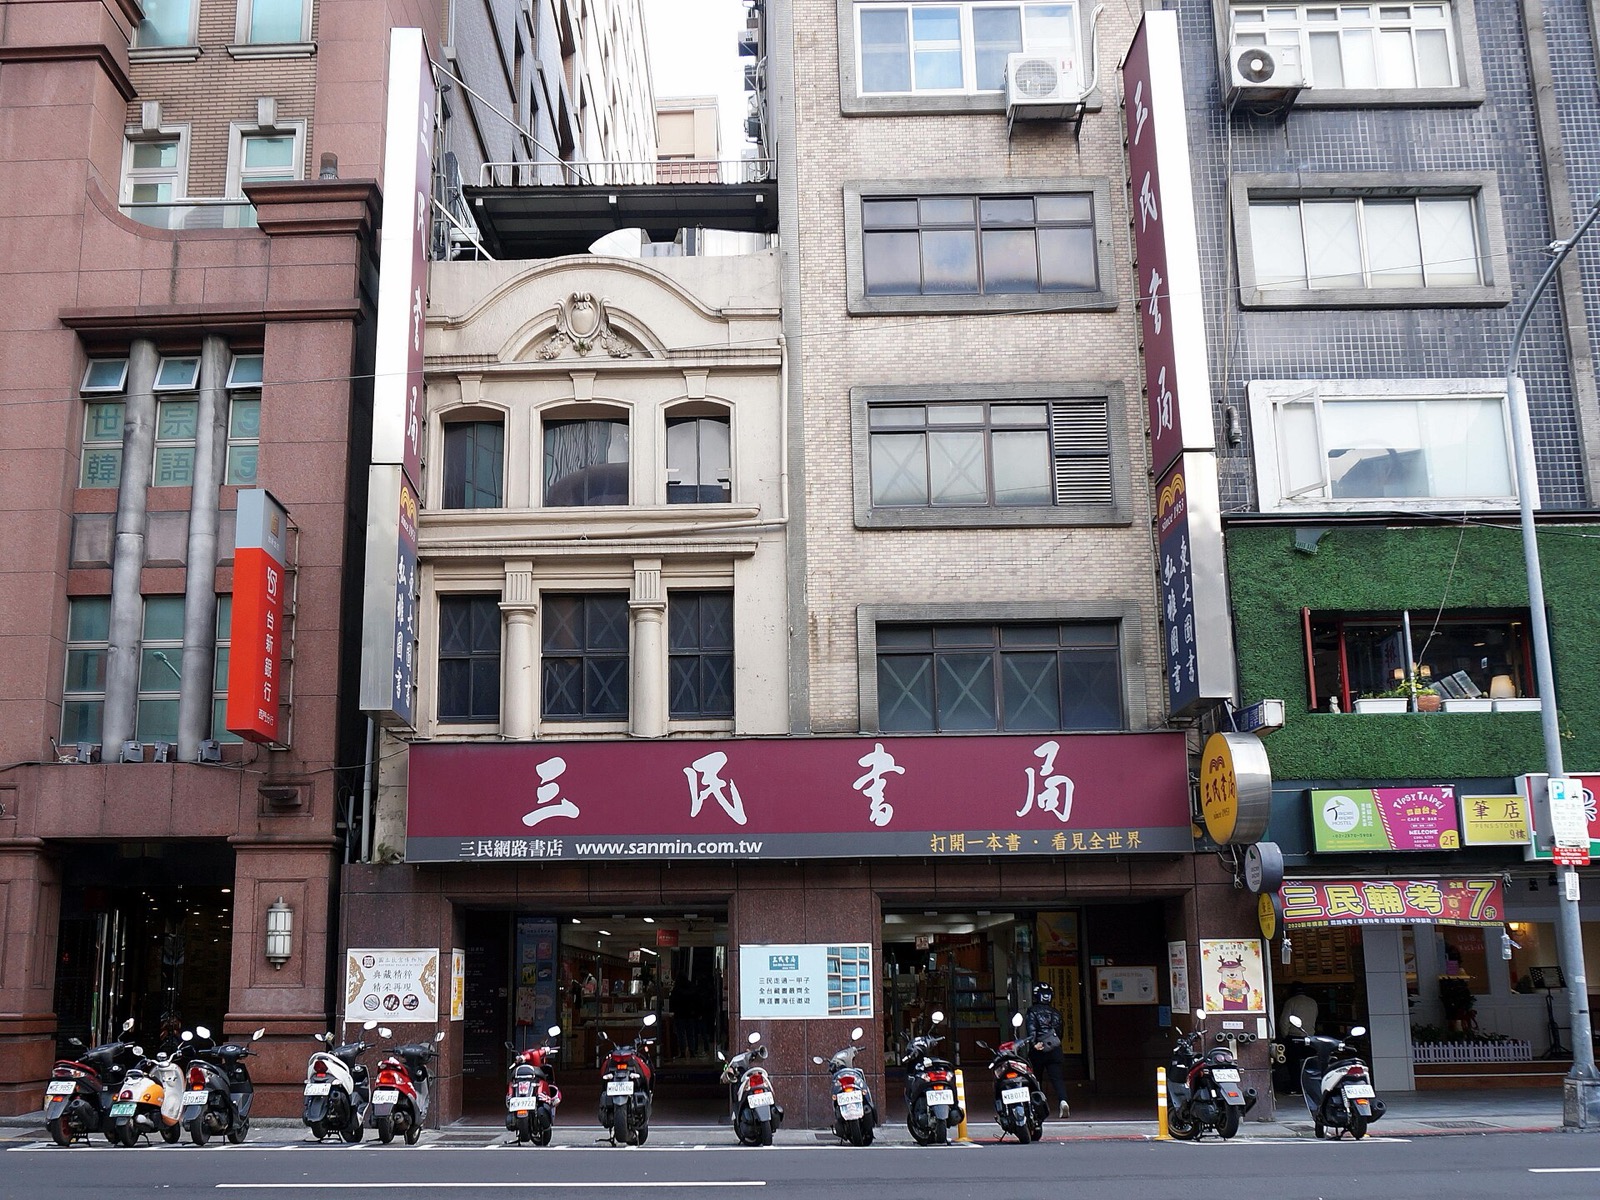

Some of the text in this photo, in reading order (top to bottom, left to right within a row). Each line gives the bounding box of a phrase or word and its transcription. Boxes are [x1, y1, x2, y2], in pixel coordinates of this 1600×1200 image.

[1162, 503, 1184, 532] since 1953
[263, 610, 275, 702] 台新銀行
[1204, 770, 1236, 808] 三民書局
[1472, 800, 1520, 819] 筆店
[459, 838, 763, 858] 三民網路書店 www.sanmin.com.tw
[1442, 836, 1455, 846] 2F
[1283, 884, 1443, 918] 三民輔考
[1467, 880, 1496, 920] 7
